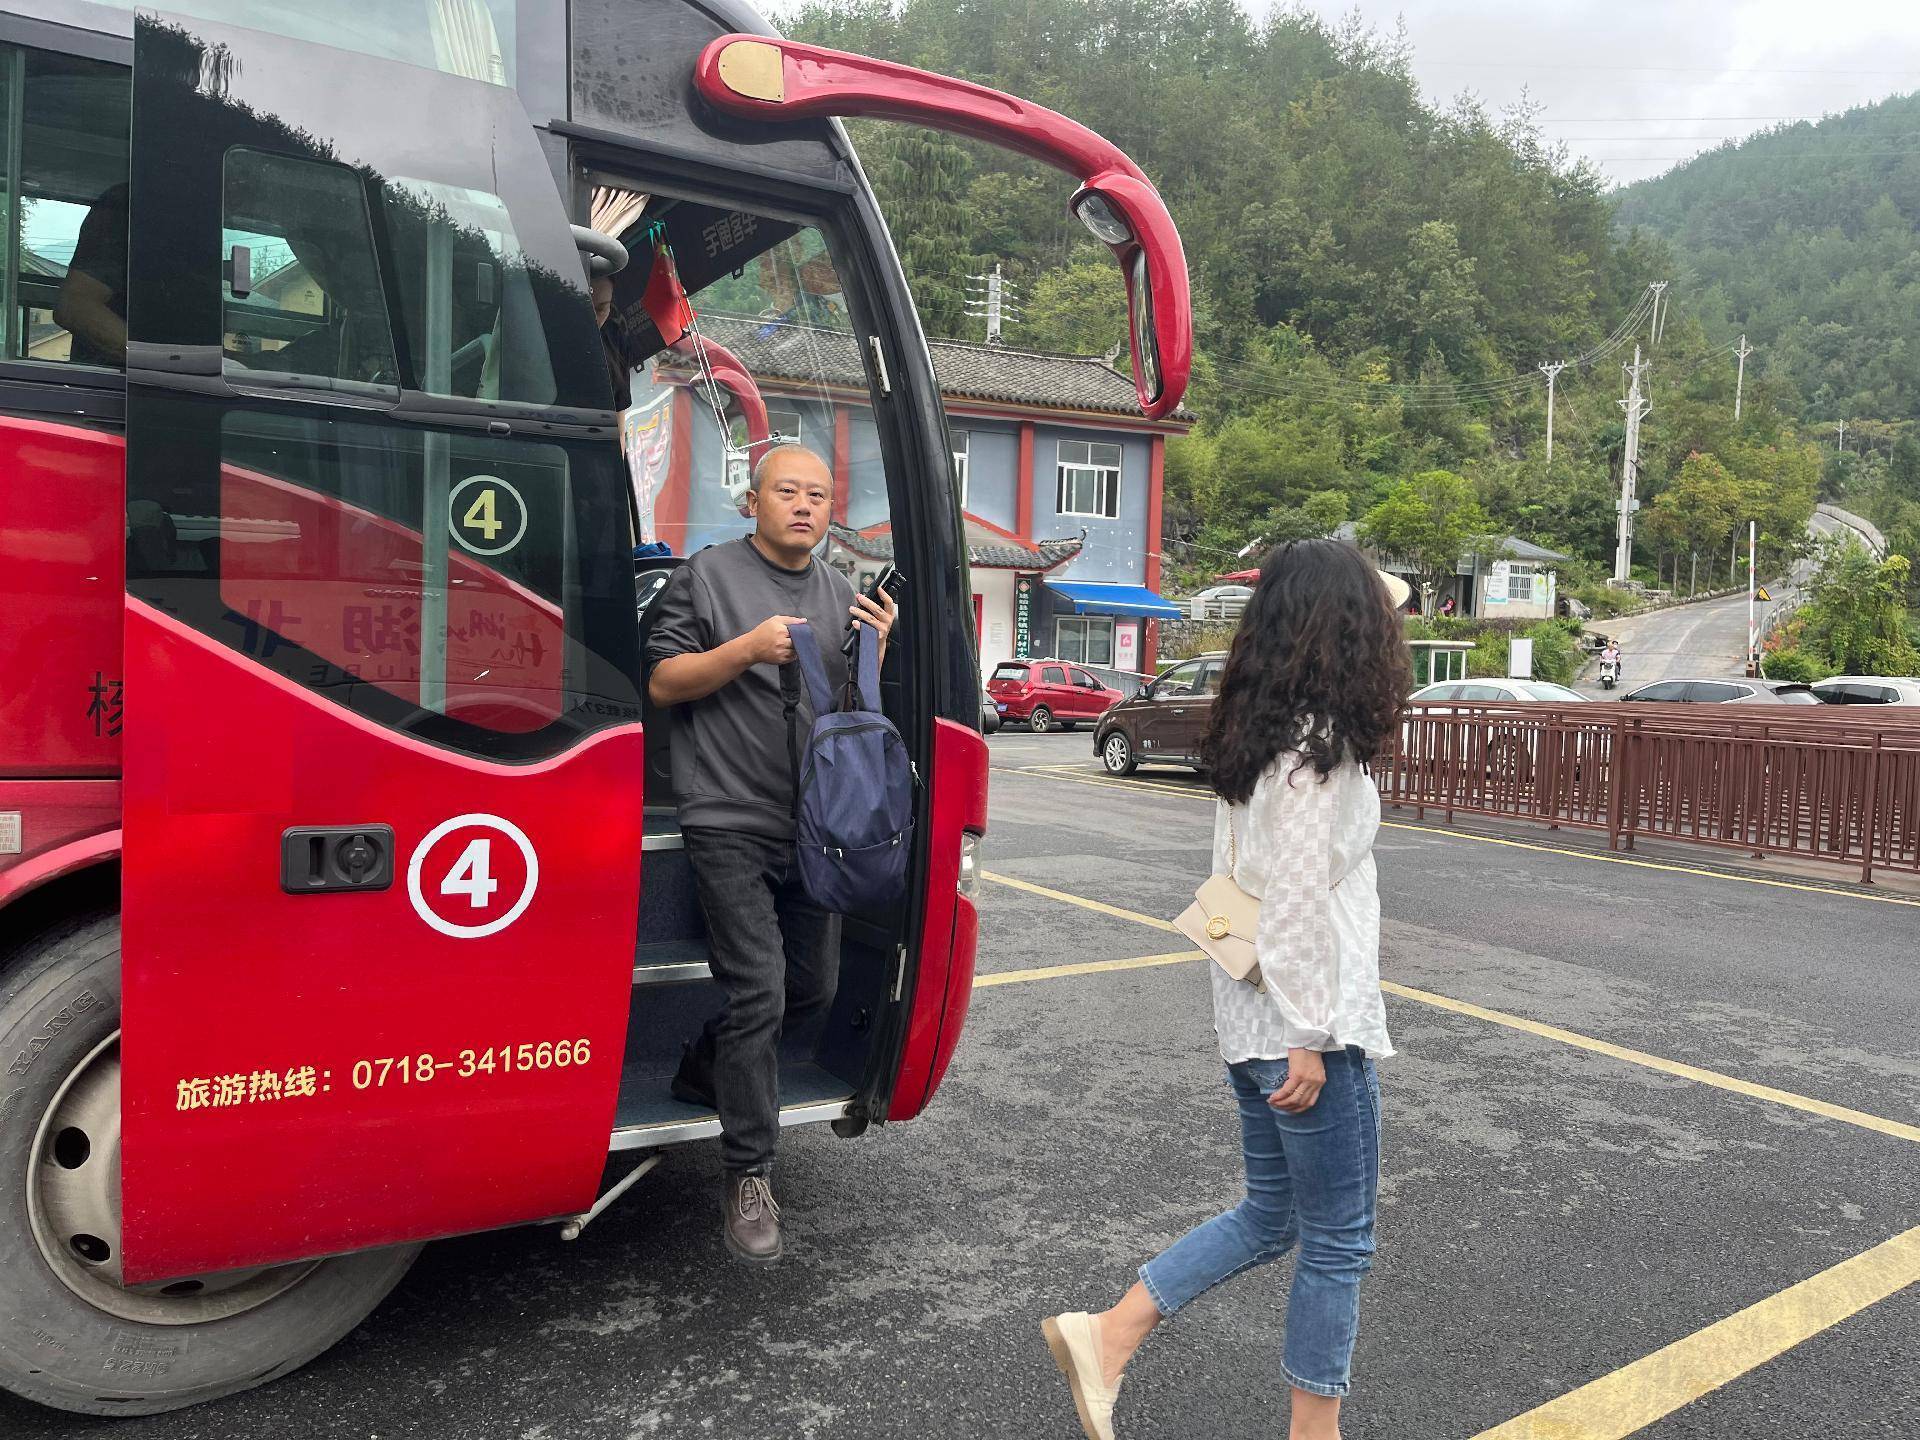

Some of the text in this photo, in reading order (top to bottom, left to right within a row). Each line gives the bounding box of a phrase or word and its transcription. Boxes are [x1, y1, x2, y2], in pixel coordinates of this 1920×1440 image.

[702, 212, 758, 258] 宇通客车
[463, 490, 504, 540] 4
[439, 838, 498, 909] 4
[352, 1038, 592, 1090] 0718-3415666
